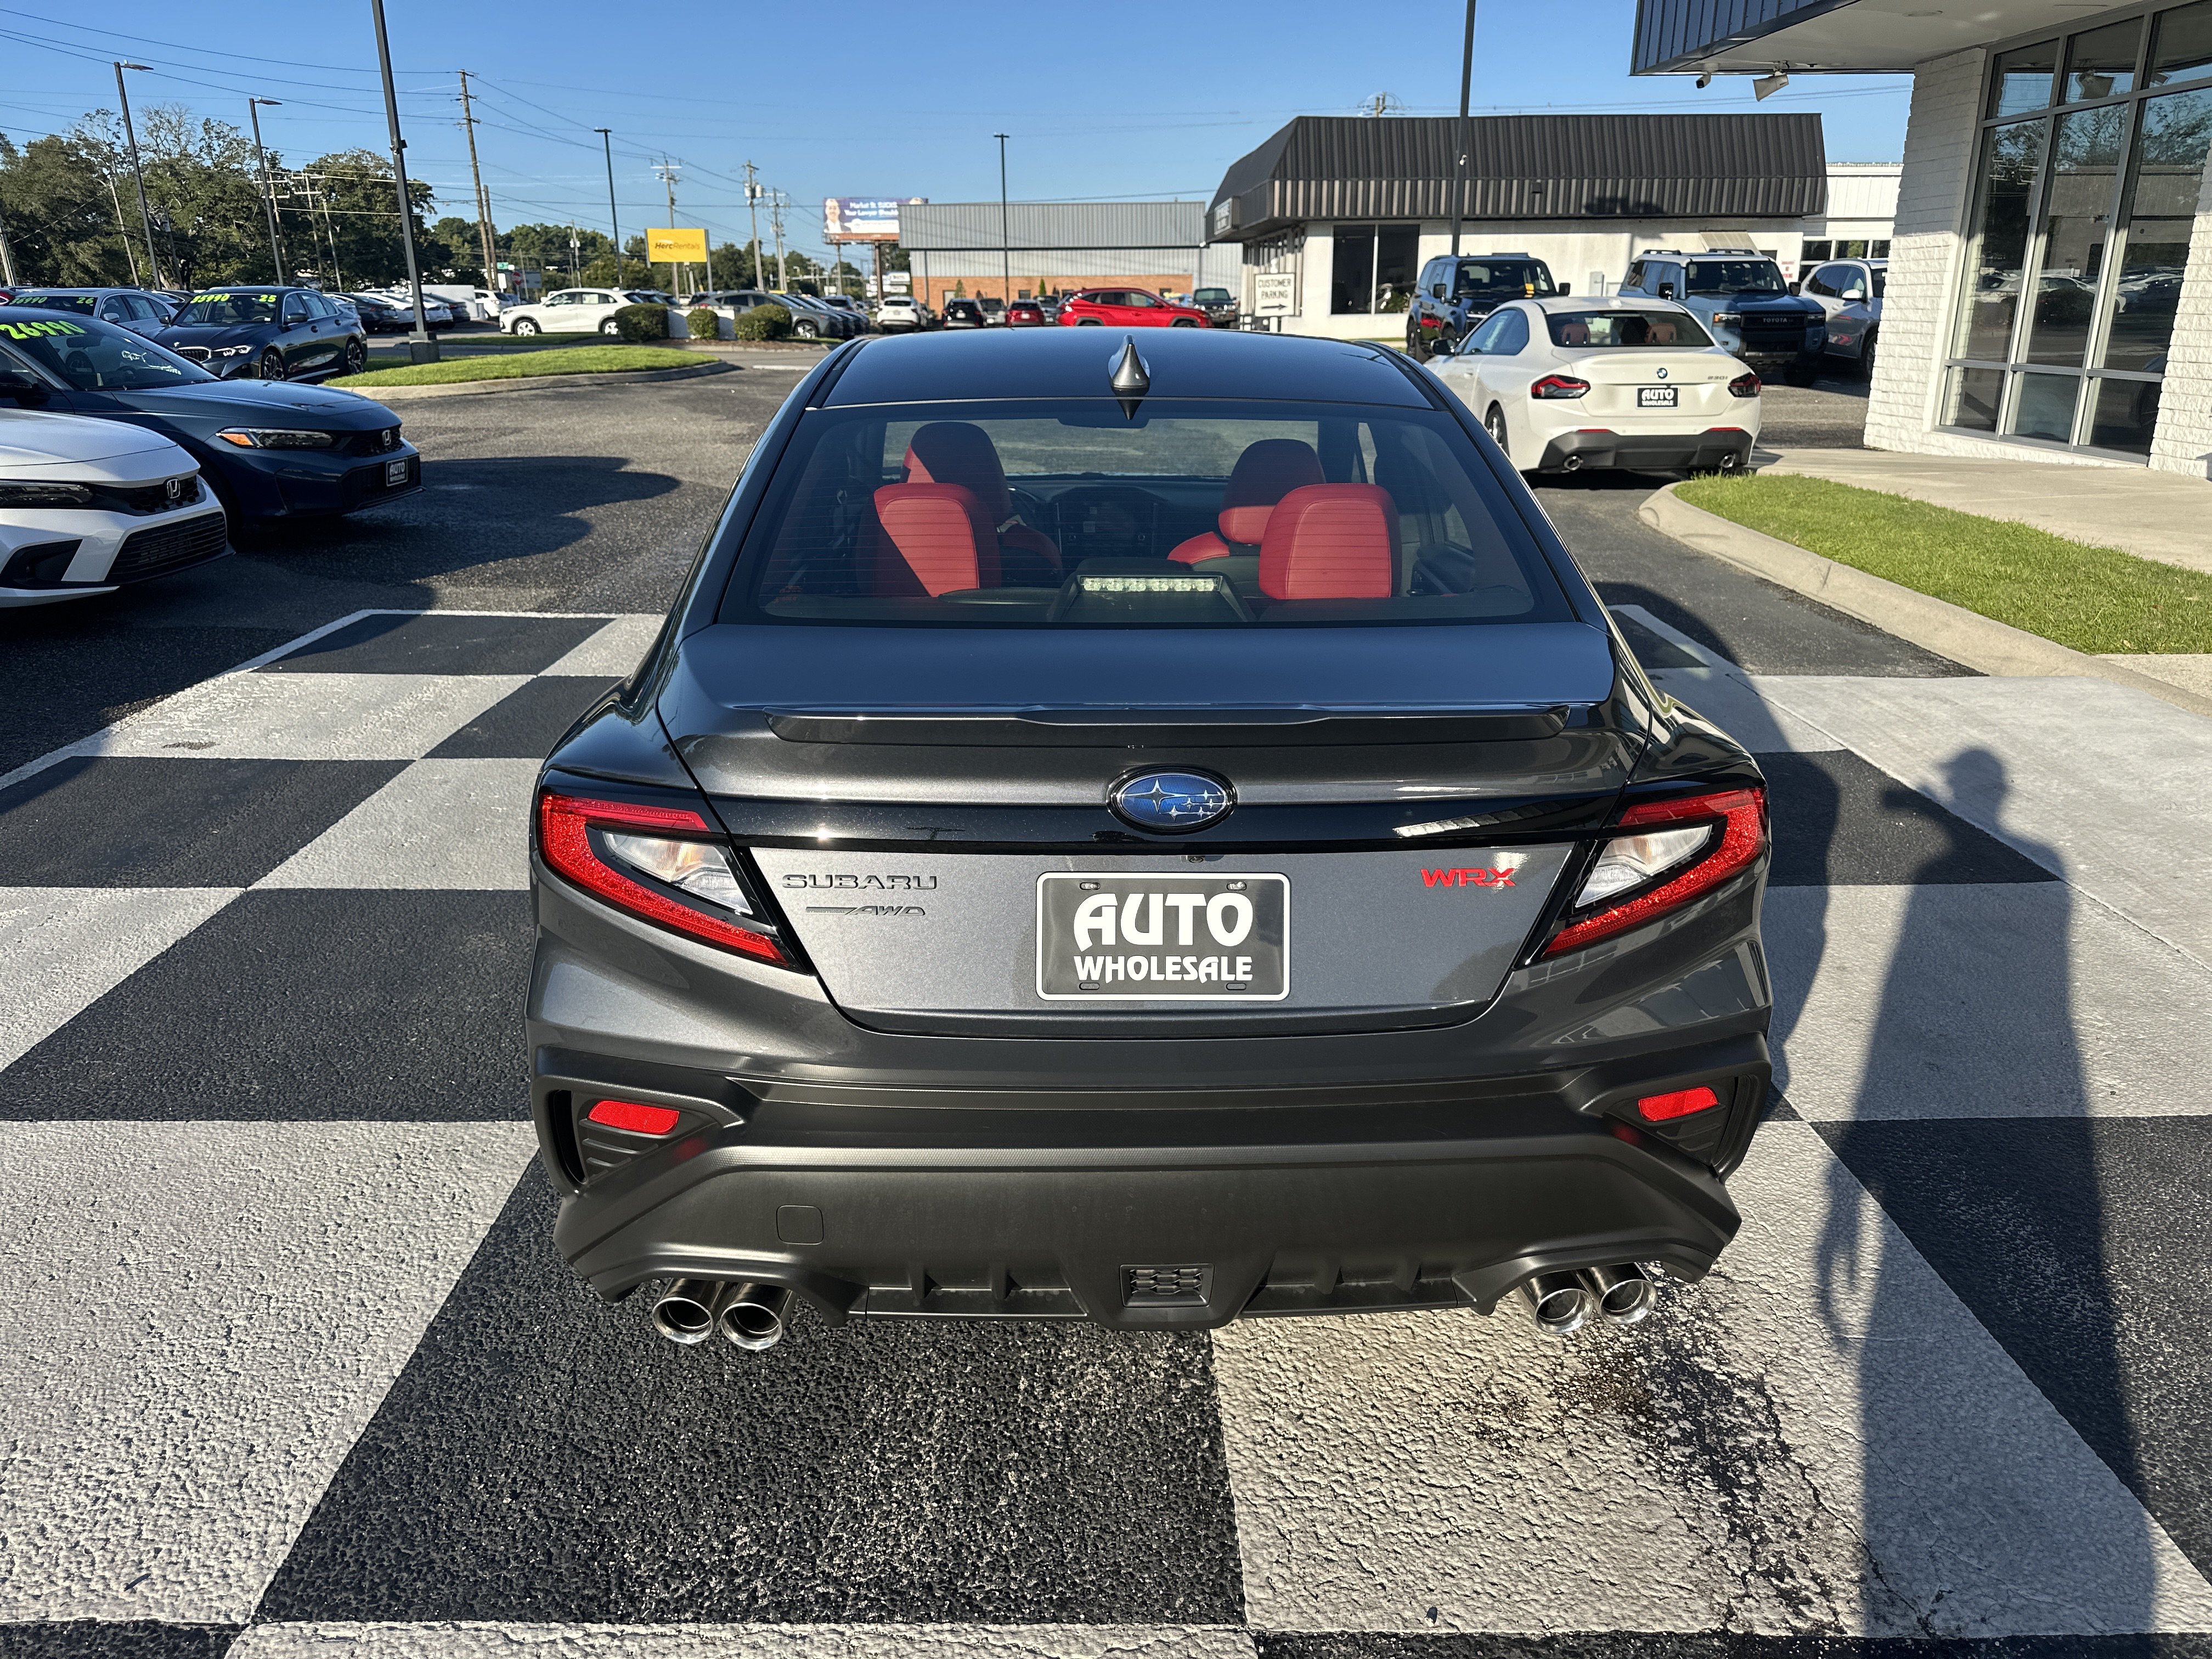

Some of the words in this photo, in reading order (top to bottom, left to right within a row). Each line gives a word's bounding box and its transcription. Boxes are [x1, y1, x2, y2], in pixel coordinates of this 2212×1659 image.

[1258, 278, 1291, 288] CUSTOMER
[259, 294, 277, 302] 25
[1261, 290, 1289, 300] PARKING
[0, 320, 88, 340] 26990
[1641, 388, 1674, 400] AUTO
[390, 462, 405, 476] AUTO
[782, 874, 937, 890] SUBARU
[1420, 868, 1517, 887] WRX
[849, 905, 926, 916] AWD
[1073, 892, 1254, 952] AUTO
[1073, 955, 1254, 984] WHOLESALE
